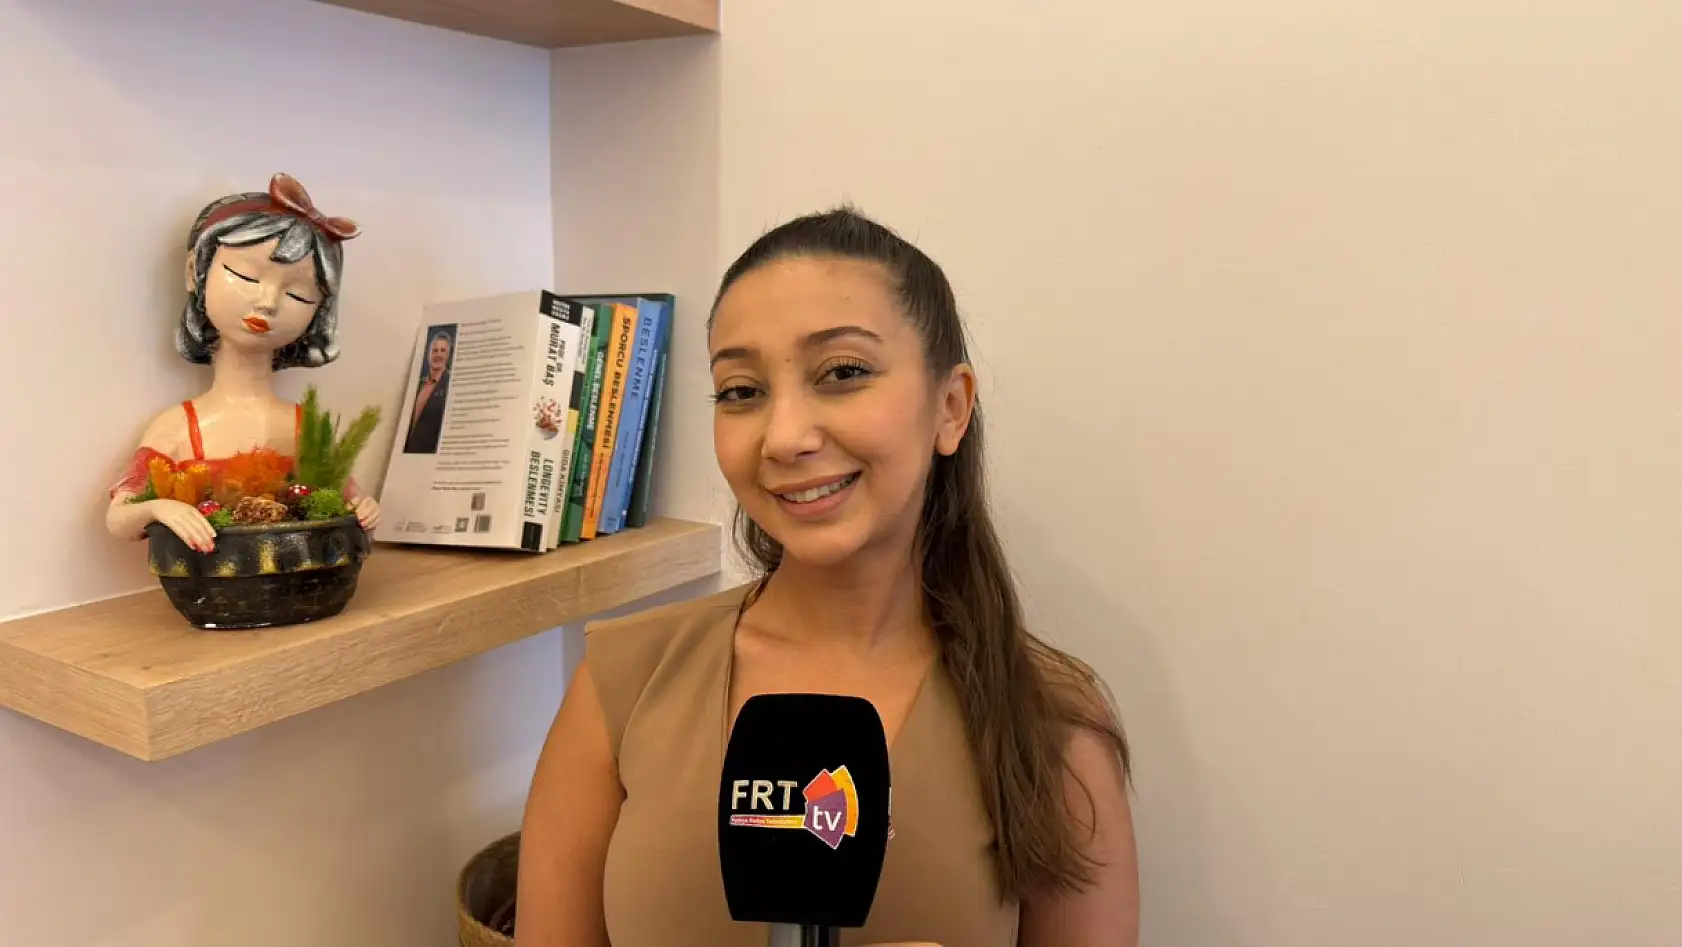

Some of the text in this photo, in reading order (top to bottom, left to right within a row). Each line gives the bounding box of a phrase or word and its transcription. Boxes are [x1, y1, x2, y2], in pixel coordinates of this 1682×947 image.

[547, 322, 561, 361] MURAT
[616, 317, 631, 367] SPORCU
[630, 317, 653, 400] BESLENME
[542, 364, 555, 387] BAŞ
[536, 458, 554, 515] LONGEVITY
[731, 780, 798, 810] FRT
[813, 805, 842, 832] tv
